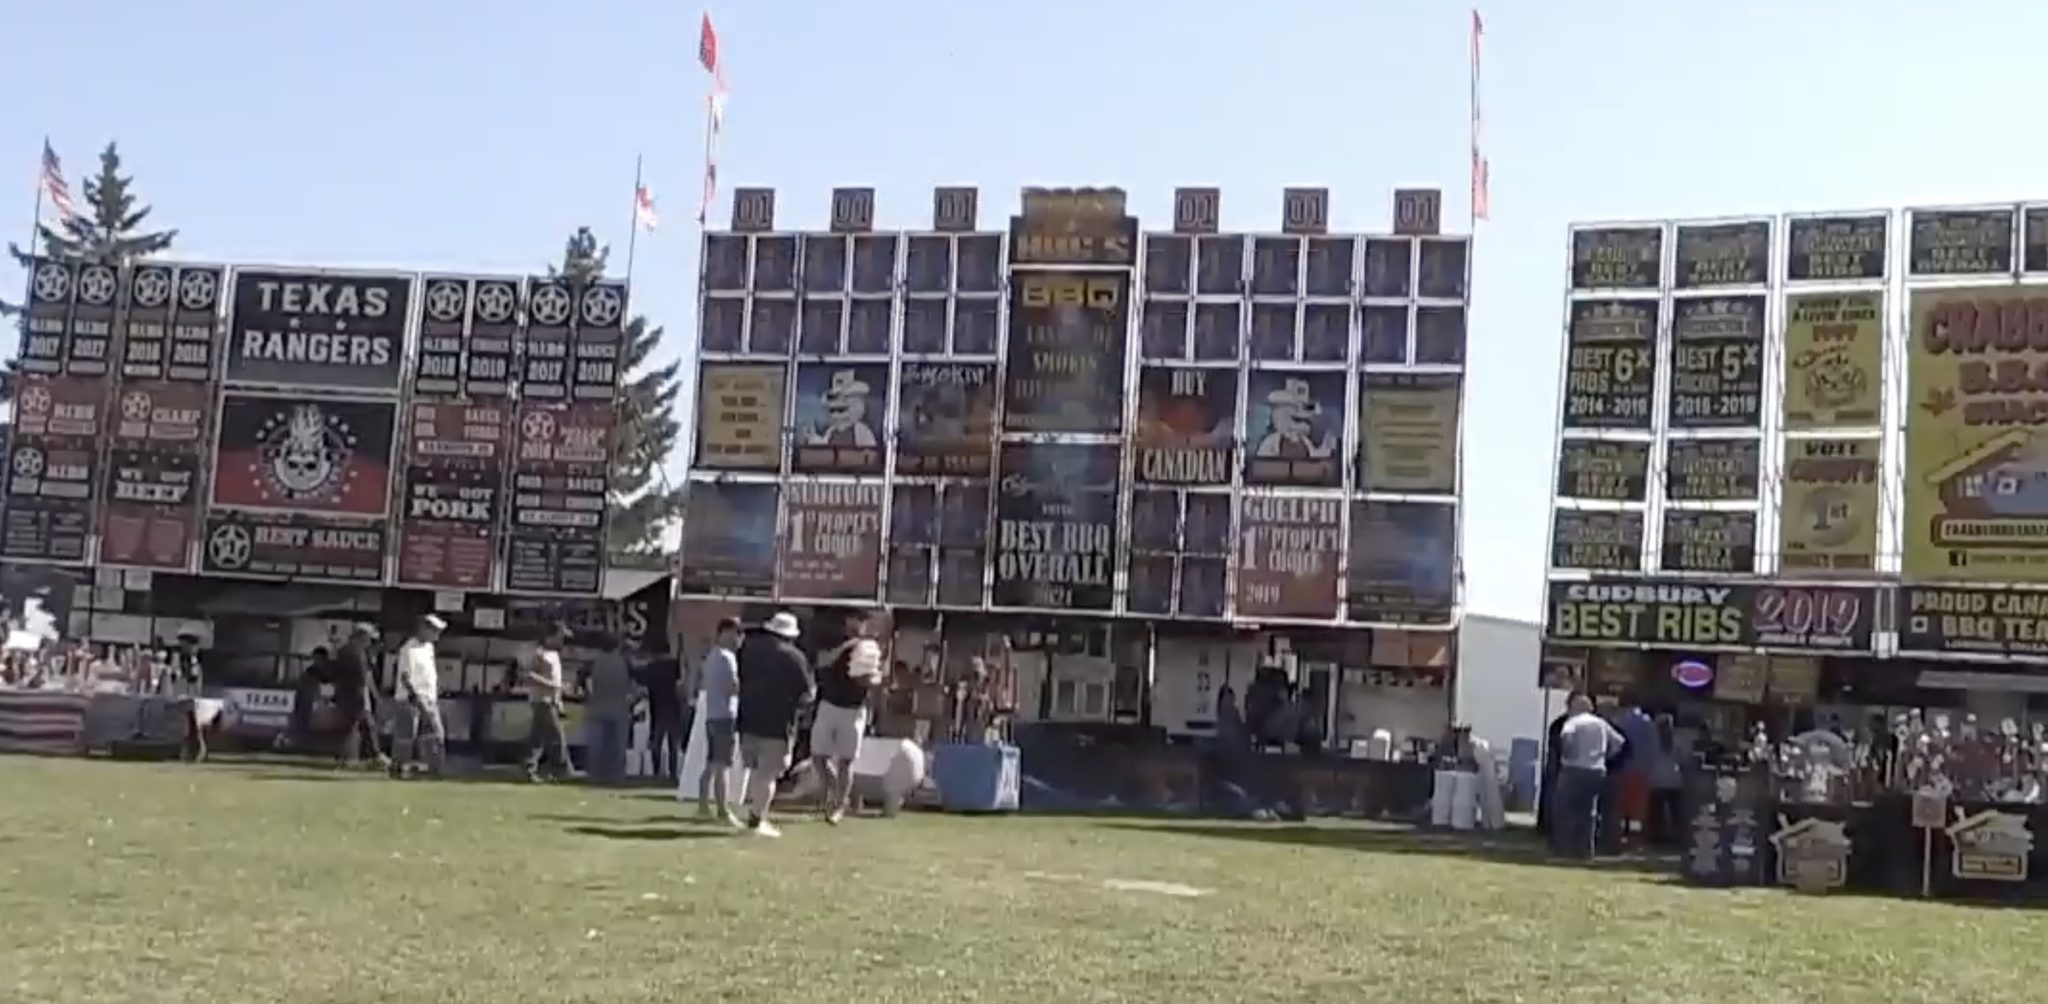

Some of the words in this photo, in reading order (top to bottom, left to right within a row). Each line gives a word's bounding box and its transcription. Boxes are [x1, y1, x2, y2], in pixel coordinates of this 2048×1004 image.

[257, 281, 389, 317] TEXAS
[1022, 277, 1119, 308] BBQ
[241, 329, 392, 366] RANGERS
[1571, 348, 1612, 368] BEST
[1676, 347, 1718, 369] BEST
[1142, 449, 1227, 481] CANADIAN
[410, 499, 491, 521] PORK
[254, 526, 308, 547] BEST
[312, 527, 381, 549] SAUCE
[1001, 520, 1054, 550] BEST
[1063, 522, 1111, 555] BBQ
[999, 552, 1109, 584] OVERALL
[1567, 584, 1733, 605] SUDBURY
[1911, 590, 1988, 612] PROUD
[1555, 603, 1647, 637] BEST
[1656, 605, 1744, 643] RIBS
[1753, 591, 1862, 635] 2019
[1941, 615, 1996, 640] BBQ
